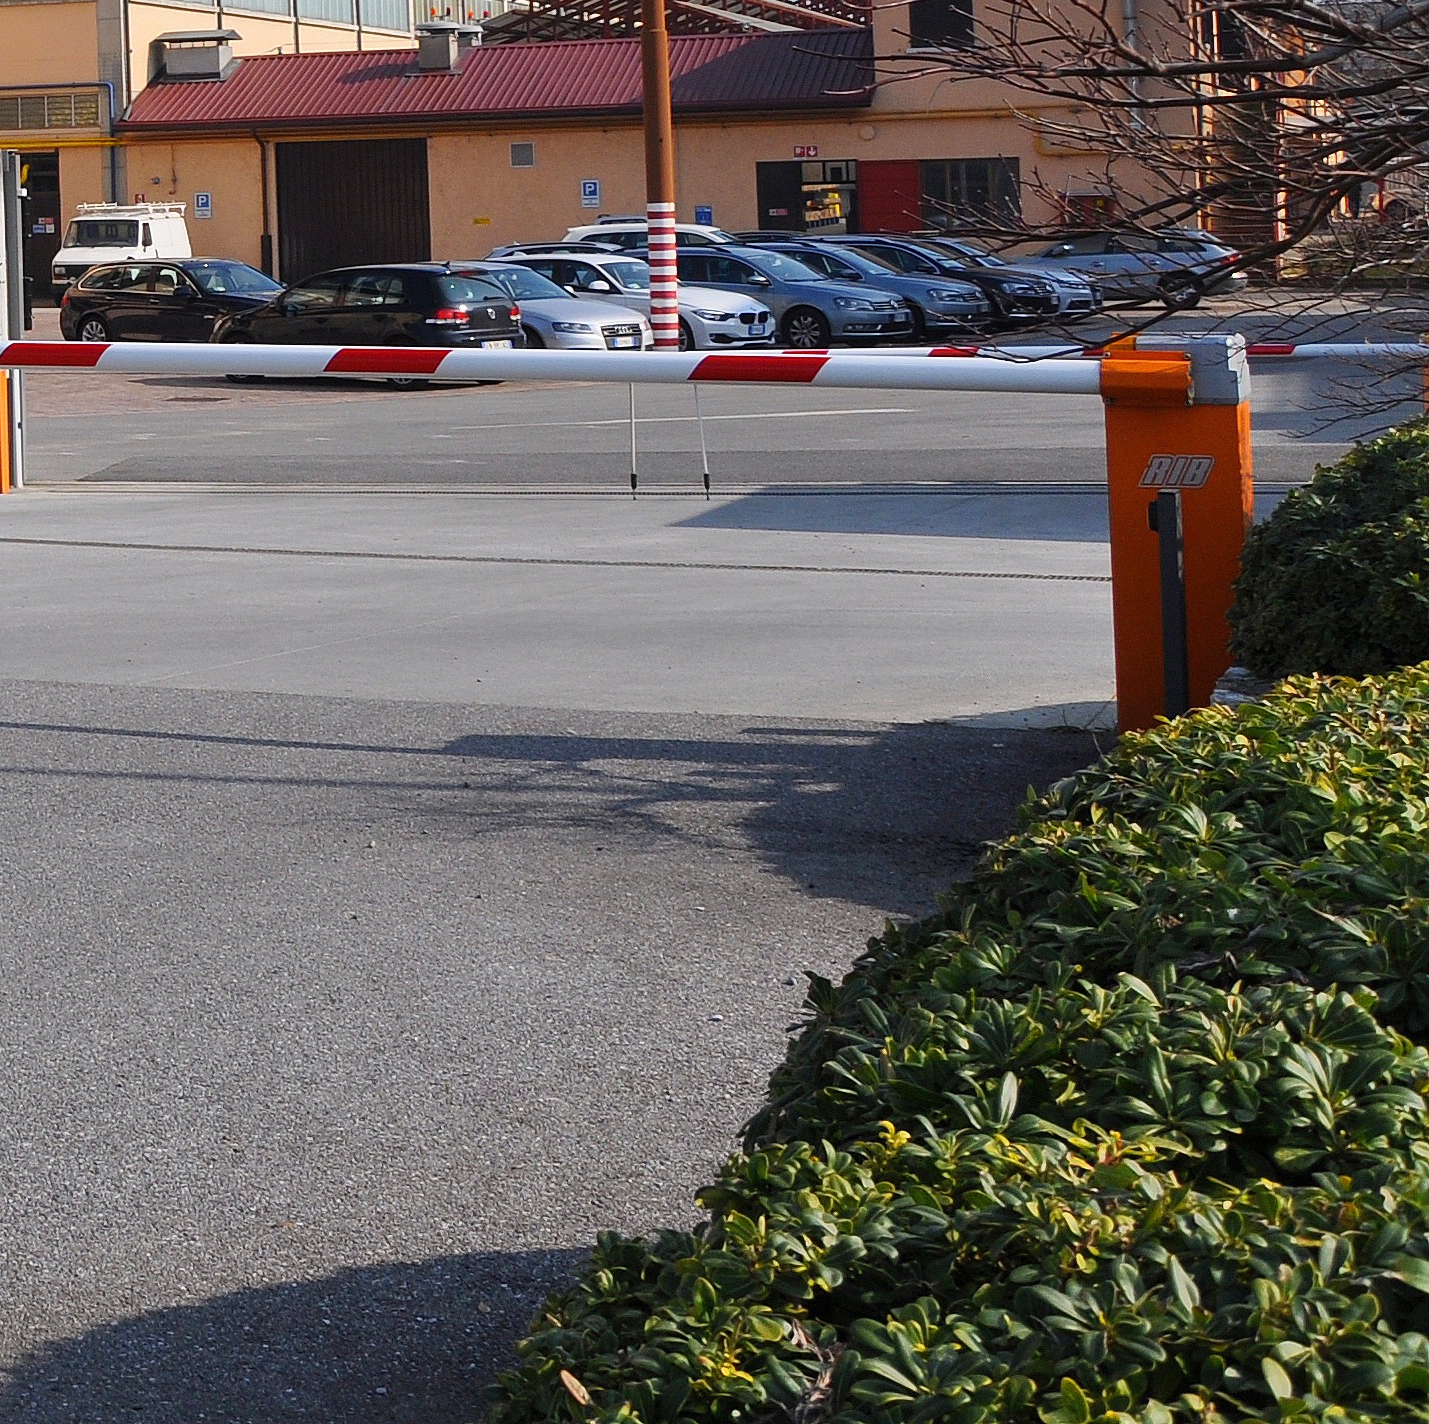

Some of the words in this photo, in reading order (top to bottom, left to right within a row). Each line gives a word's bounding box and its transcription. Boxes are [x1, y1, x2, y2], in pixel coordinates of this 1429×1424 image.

[585, 183, 595, 195] P
[198, 195, 207, 207] P
[1140, 455, 1213, 486] RIB
